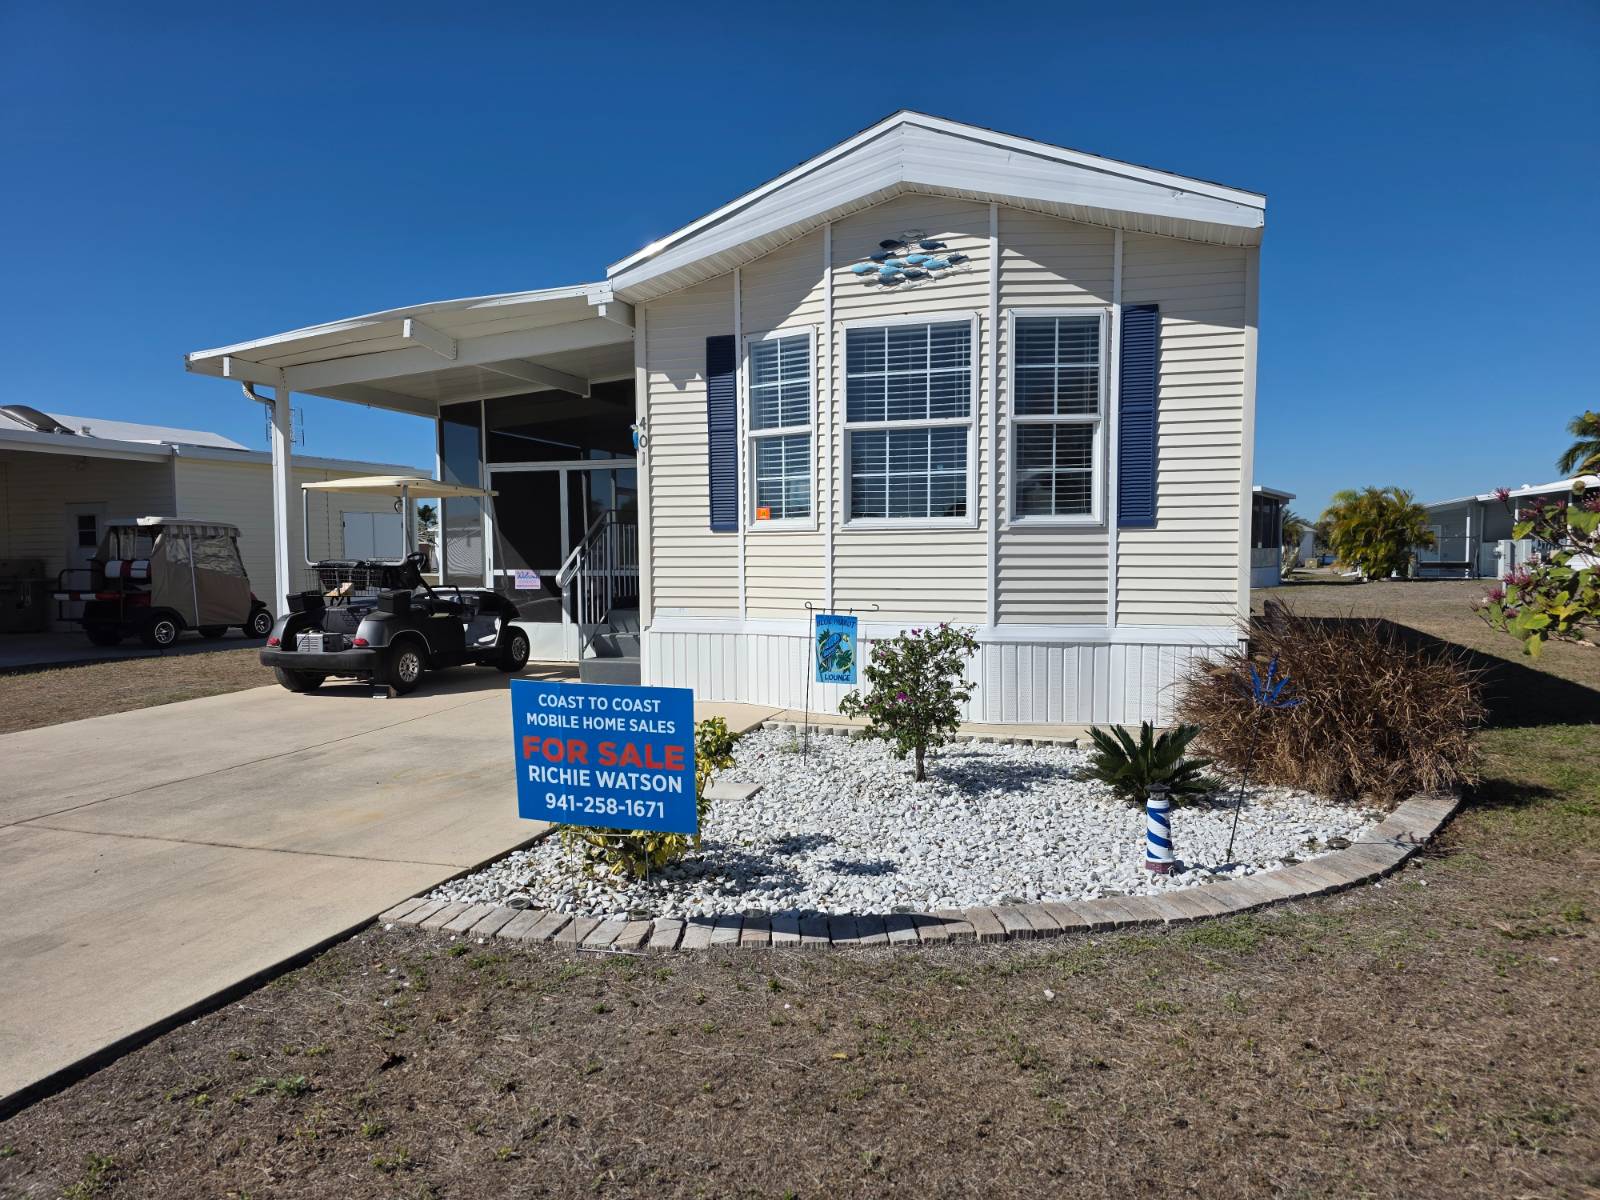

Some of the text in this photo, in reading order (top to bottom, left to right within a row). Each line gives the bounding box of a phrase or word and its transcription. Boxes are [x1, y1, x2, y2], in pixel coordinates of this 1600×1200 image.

[639, 416, 648, 466] 401
[824, 673, 851, 682] LOUNGE
[538, 694, 661, 713] COAST TO COAST
[526, 712, 676, 734] MOBILE HOME SALES
[522, 735, 686, 771] FOR SALE
[528, 765, 682, 794] RICHIE WATSON
[545, 793, 665, 819] 941-258-1671
